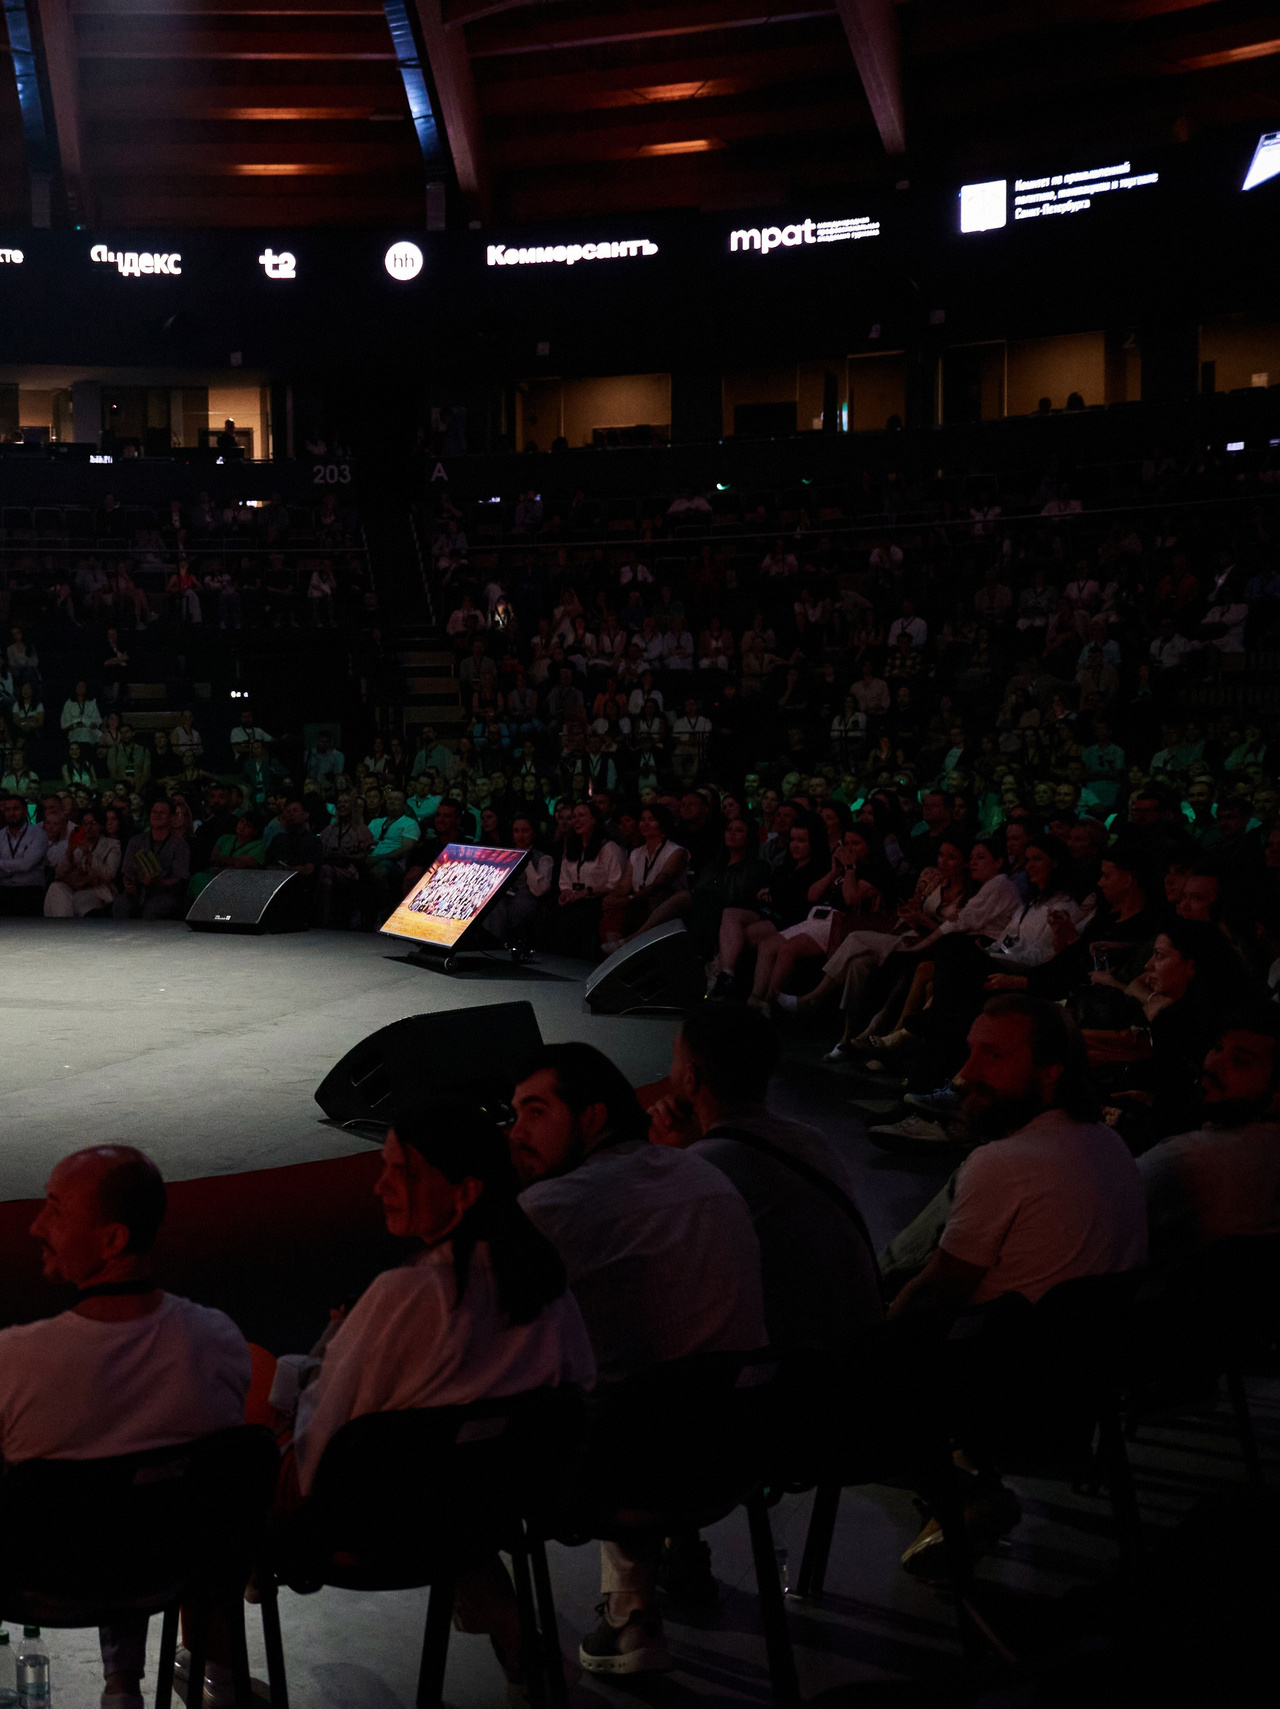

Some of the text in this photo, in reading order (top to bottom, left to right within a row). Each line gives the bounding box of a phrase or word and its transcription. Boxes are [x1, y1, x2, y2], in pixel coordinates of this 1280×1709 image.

[393, 253, 415, 269] hh
[486, 239, 659, 266] Коммерсантъ
[259, 248, 296, 279] t2
[312, 464, 351, 484] 203
[430, 461, 449, 482] A
